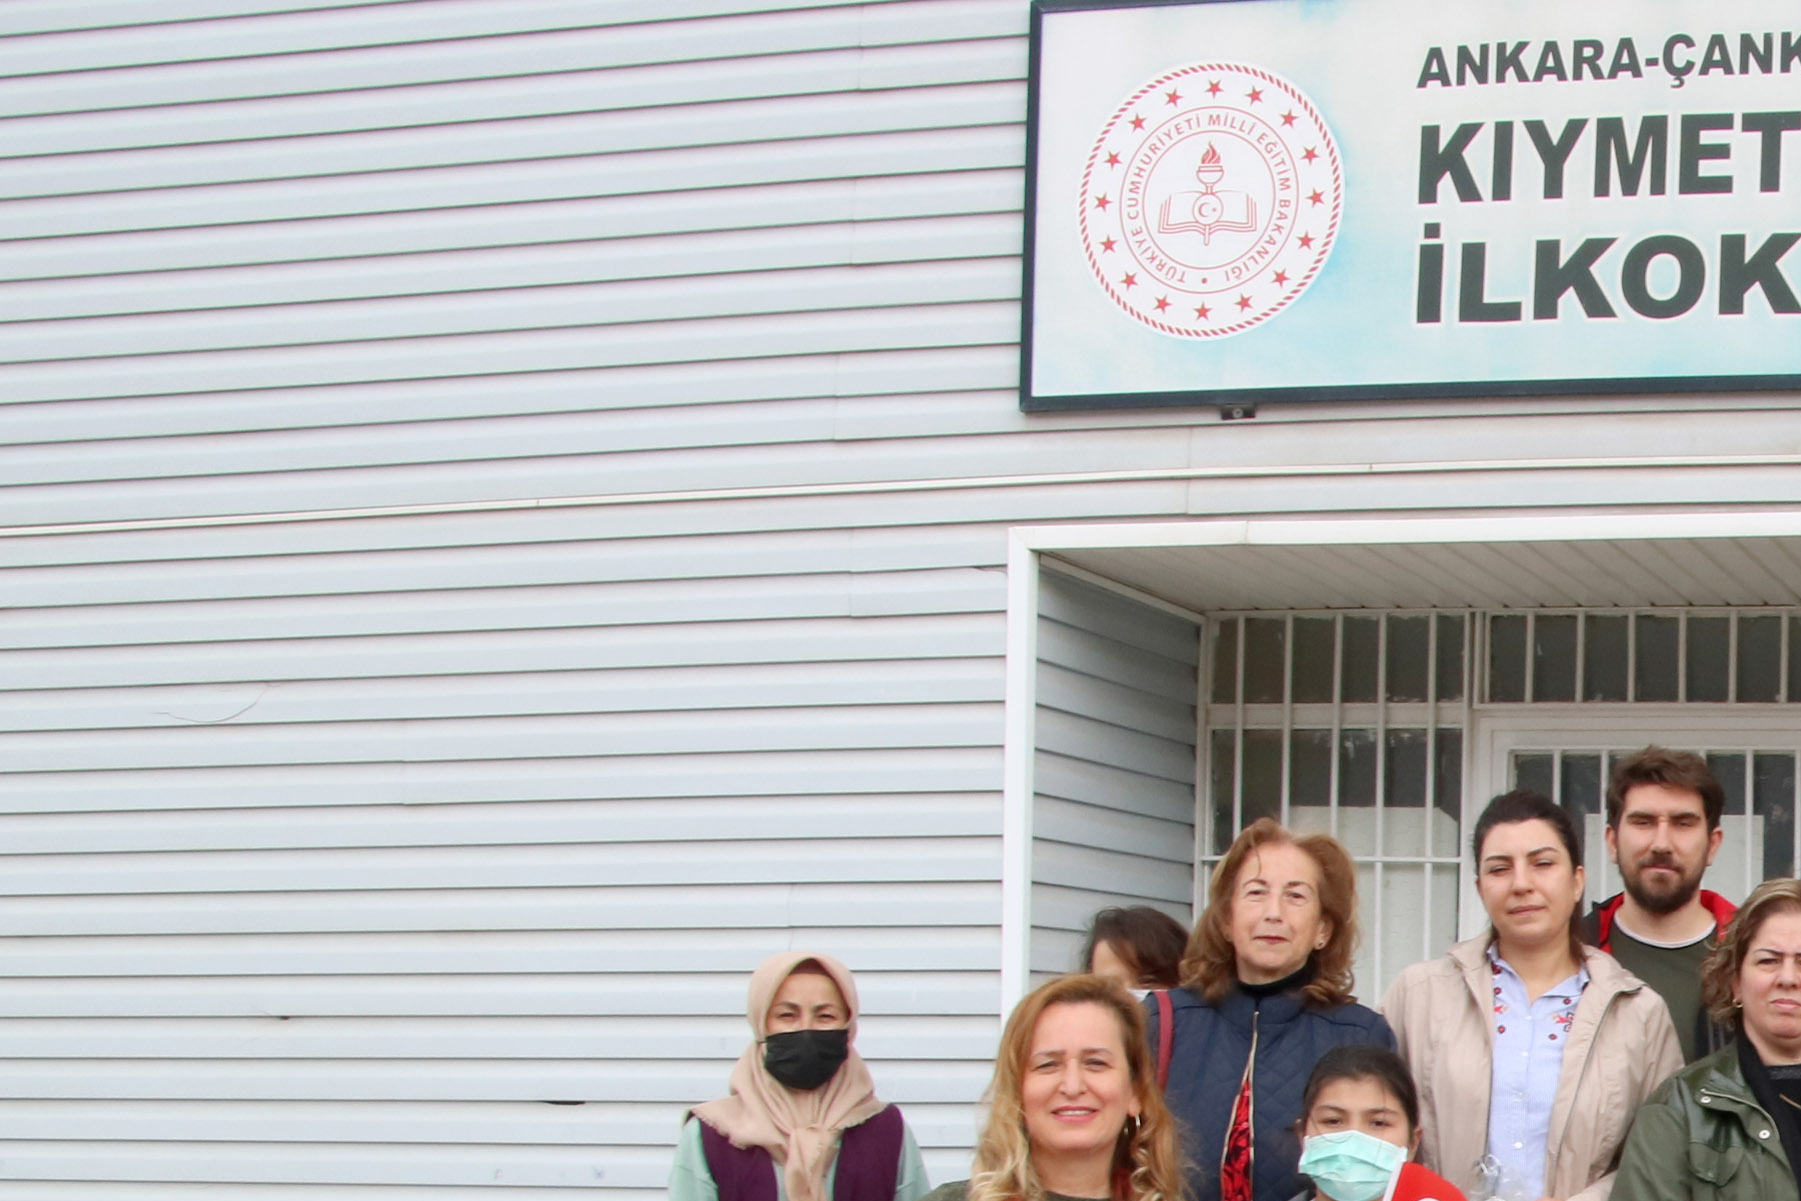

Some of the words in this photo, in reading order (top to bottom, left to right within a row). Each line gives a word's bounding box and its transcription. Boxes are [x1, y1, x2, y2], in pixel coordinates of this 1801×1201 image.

[1208, 112, 1257, 135] MİLLİ
[1127, 115, 1201, 220] CUMHURİYETİ
[1256, 132, 1291, 191] EĞİTİM
[1131, 226, 1187, 283] TÜRKİYE
[1225, 199, 1291, 281] BAKANLIĞI
